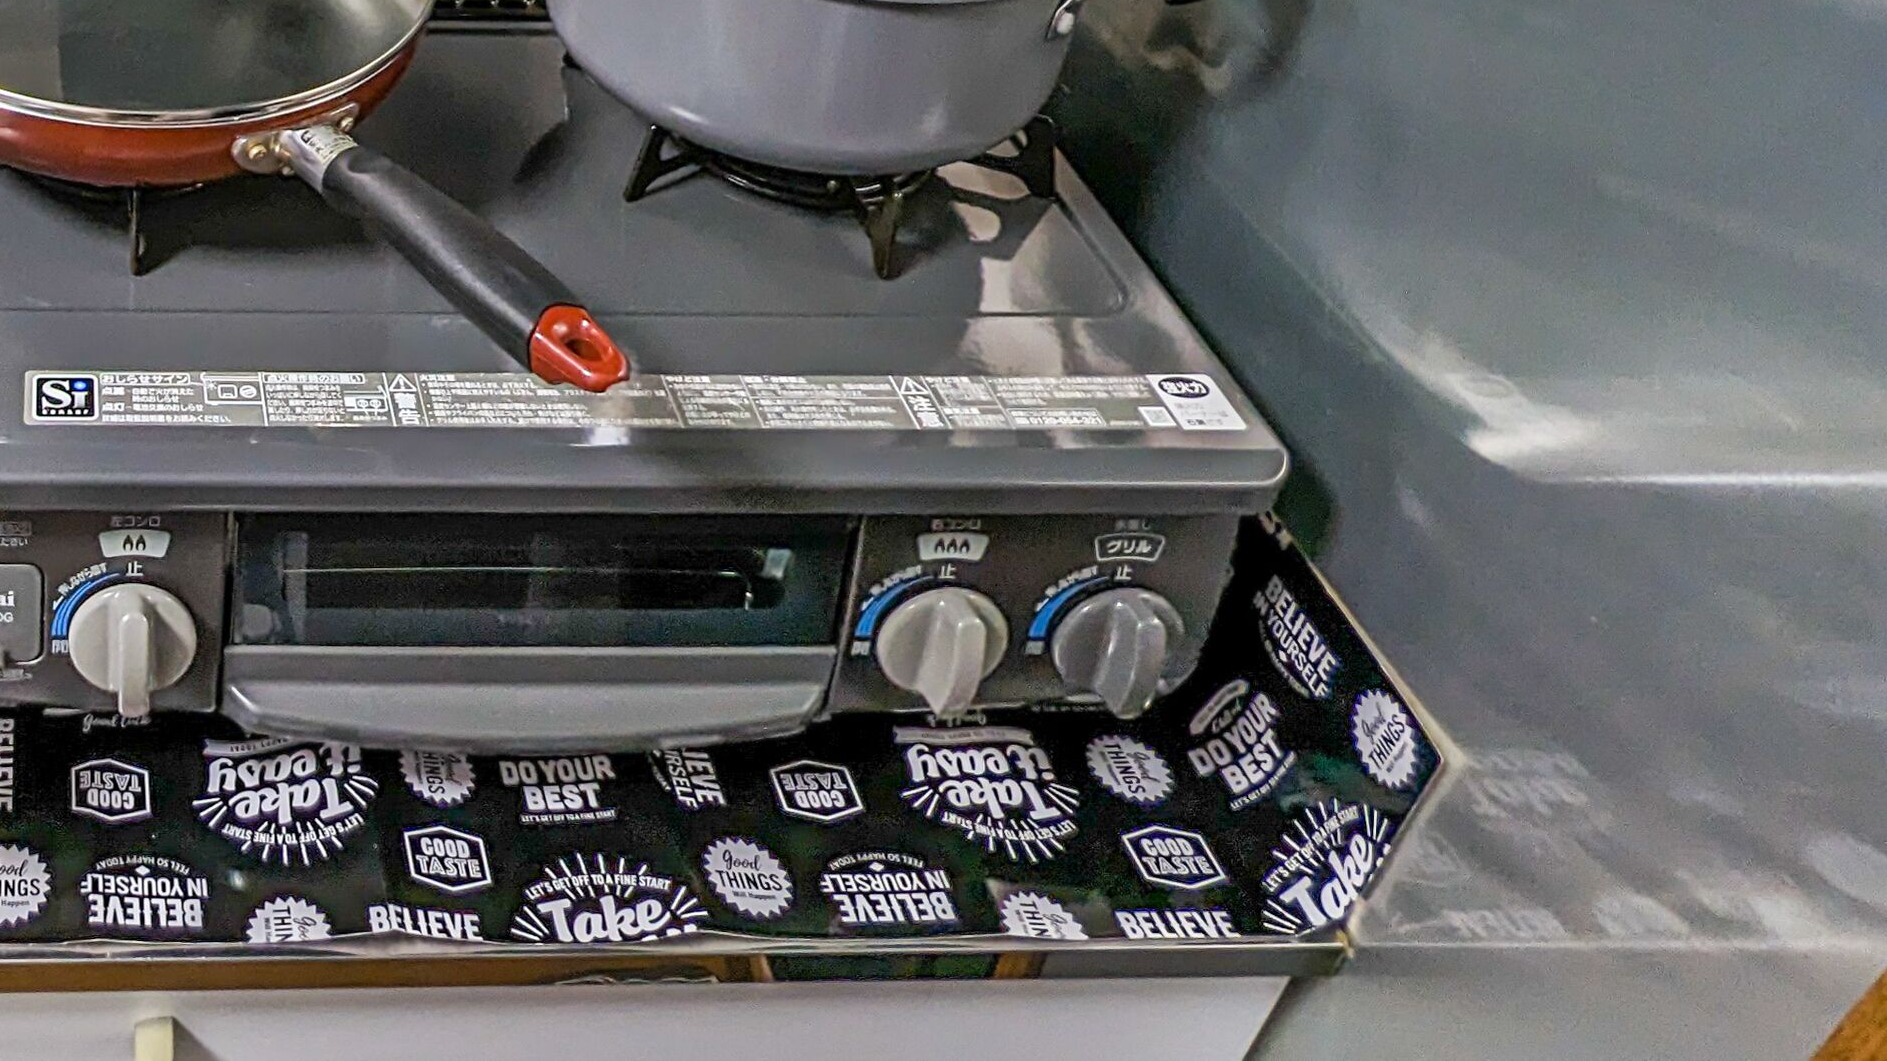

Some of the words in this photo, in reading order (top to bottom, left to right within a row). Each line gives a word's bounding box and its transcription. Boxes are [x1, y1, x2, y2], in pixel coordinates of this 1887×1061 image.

[101, 374, 189, 384] おしらせサイン
[41, 379, 89, 410] Si
[1106, 540, 1153, 554] グリル
[125, 560, 144, 577] 止
[939, 564, 956, 580] 止
[1114, 565, 1133, 581] 止
[1265, 574, 1340, 682] BELIEVE
[1267, 609, 1329, 699] YOURSELF
[1187, 738, 1234, 777] DO
[1223, 692, 1280, 754] YOUR
[1367, 714, 1406, 770] THINGS
[206, 748, 317, 794] easy
[498, 760, 538, 787] DO
[537, 754, 617, 785] YOUR
[906, 743, 1011, 783] easy
[1006, 744, 1056, 781] it
[1221, 728, 1282, 795] BEST
[79, 770, 142, 792] TASTE
[778, 771, 848, 791] TASTE
[86, 791, 135, 810] GOOD
[228, 777, 355, 825] Take
[522, 783, 601, 812] BEST
[793, 789, 846, 809] GOOD
[938, 777, 1062, 820] Take
[419, 836, 471, 859] GOOD
[1140, 837, 1194, 857] GOOD
[415, 854, 483, 879] TASTE
[923, 869, 951, 890] IN
[1141, 855, 1215, 876] TASTE
[80, 873, 185, 898] YOURSELF
[187, 877, 209, 898] IN
[524, 881, 553, 900] LET'S
[552, 876, 572, 891] GET
[571, 873, 590, 888] OFF
[591, 874, 605, 886] TO
[604, 873, 613, 886] A
[613, 873, 638, 887] FINE
[638, 875, 671, 891] START
[715, 869, 783, 891] THINGS
[819, 872, 928, 893] YOURSELF
[1279, 833, 1374, 927] Take
[87, 893, 204, 928] BELIEVE
[536, 894, 671, 943] Take
[832, 891, 956, 923] BELIEVE
[369, 903, 484, 942] BELIEVE
[1114, 910, 1242, 940] BELIEVE
